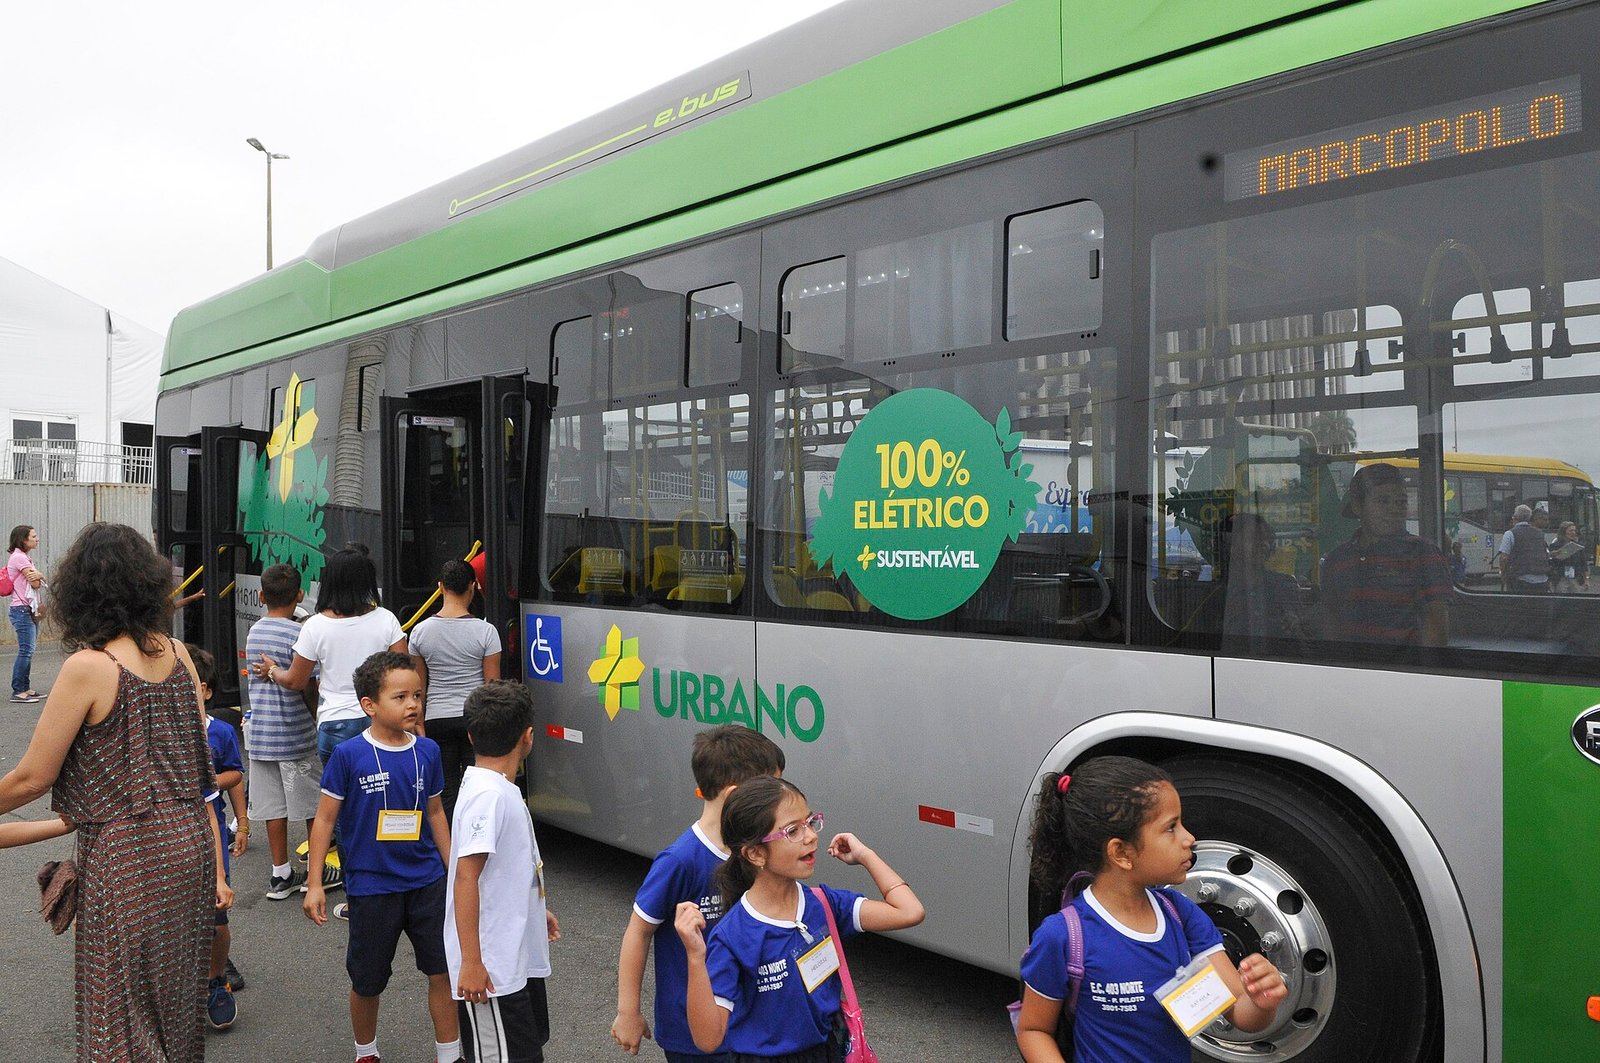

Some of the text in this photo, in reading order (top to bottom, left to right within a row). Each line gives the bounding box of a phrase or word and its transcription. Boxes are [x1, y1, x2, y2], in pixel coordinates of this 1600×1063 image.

[654, 78, 740, 128] e.bus
[1258, 94, 1564, 195] MARCOPOLO
[875, 438, 970, 489] 100%
[854, 490, 989, 529] ELÉTRICO
[877, 545, 979, 568] SUSTENTÁVEL
[652, 667, 825, 743] URBANO
[767, 958, 787, 974] NORTE
[769, 971, 789, 982] PILOTO
[1089, 980, 1145, 995] E.C. 403 NORTE
[1119, 995, 1146, 1004] PILOTO
